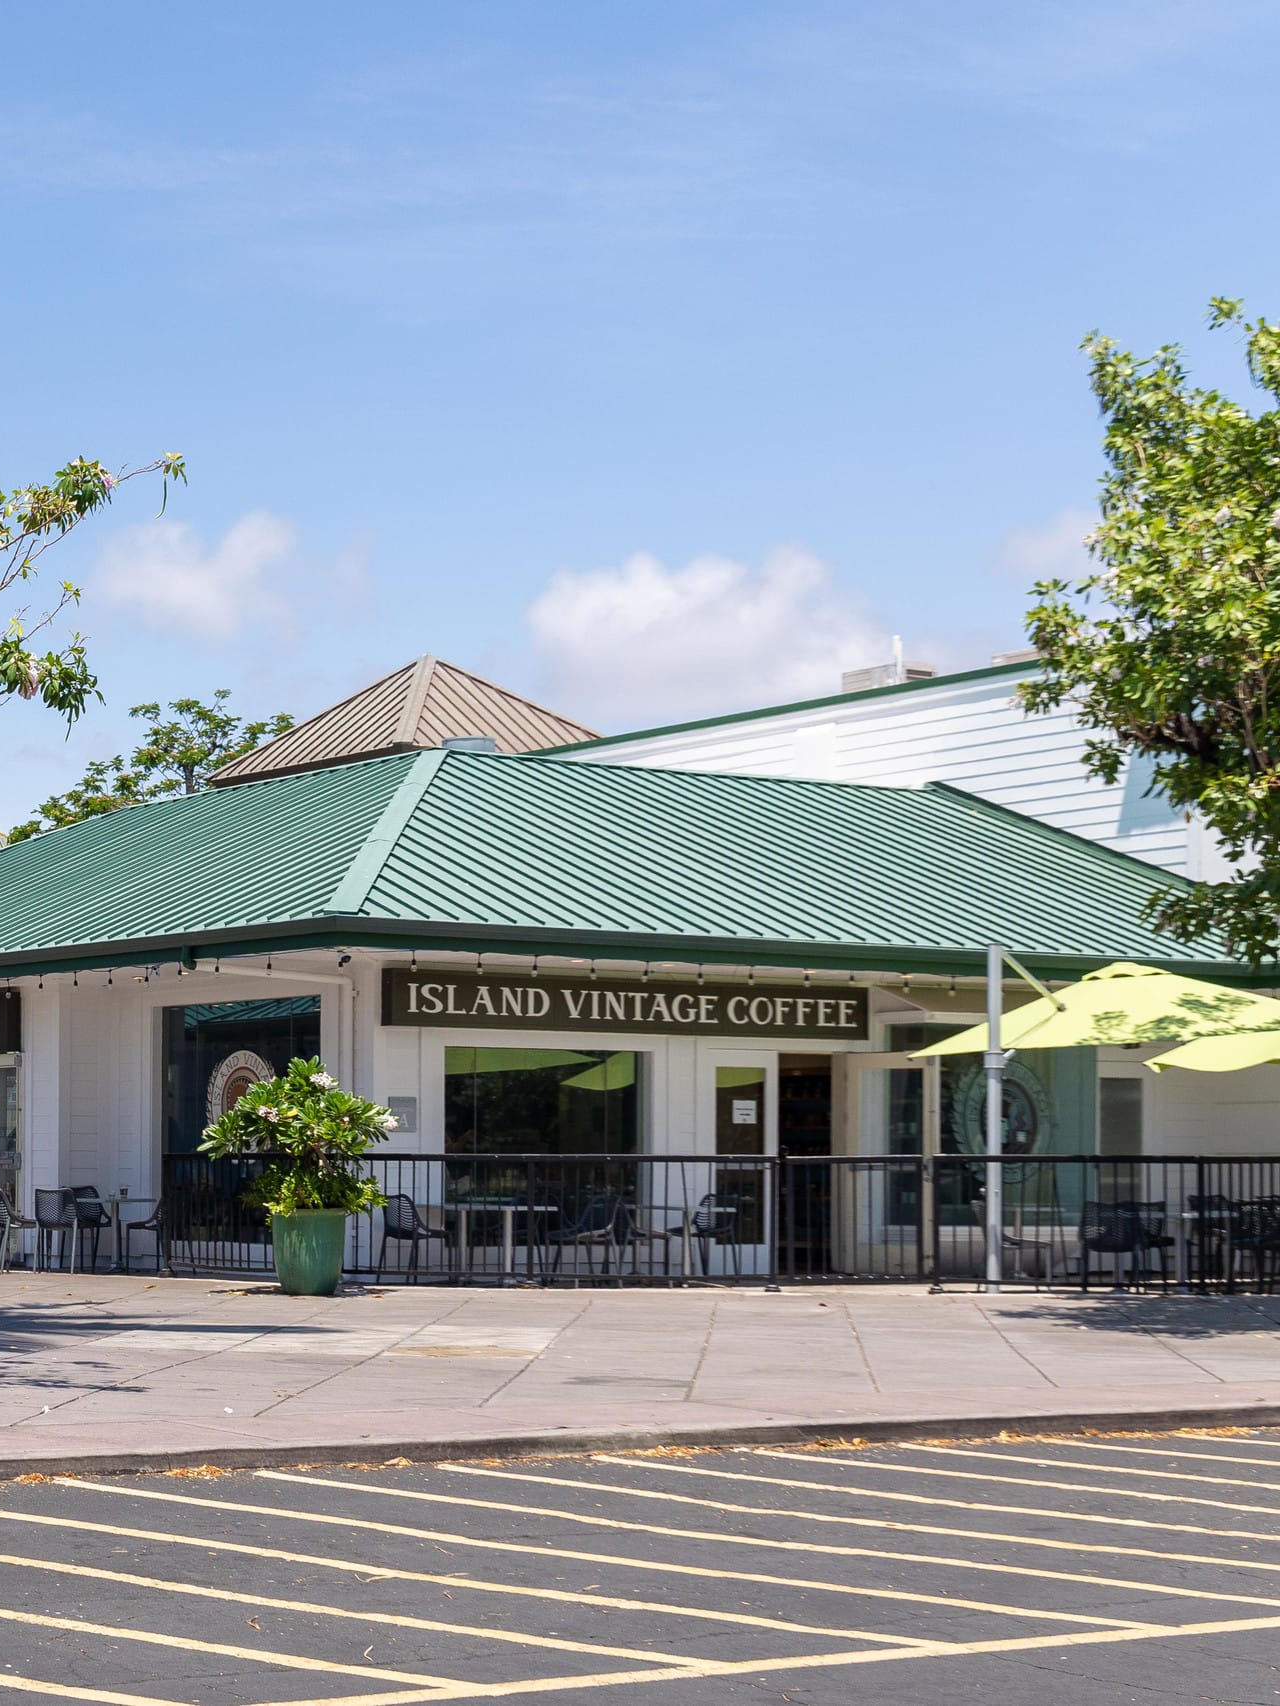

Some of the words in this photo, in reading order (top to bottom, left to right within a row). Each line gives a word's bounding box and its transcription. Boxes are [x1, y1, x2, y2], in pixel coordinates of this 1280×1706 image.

[407, 982, 551, 1017] ISLAND
[560, 989, 719, 1024] VINTAGE
[726, 996, 858, 1028] COFFEE
